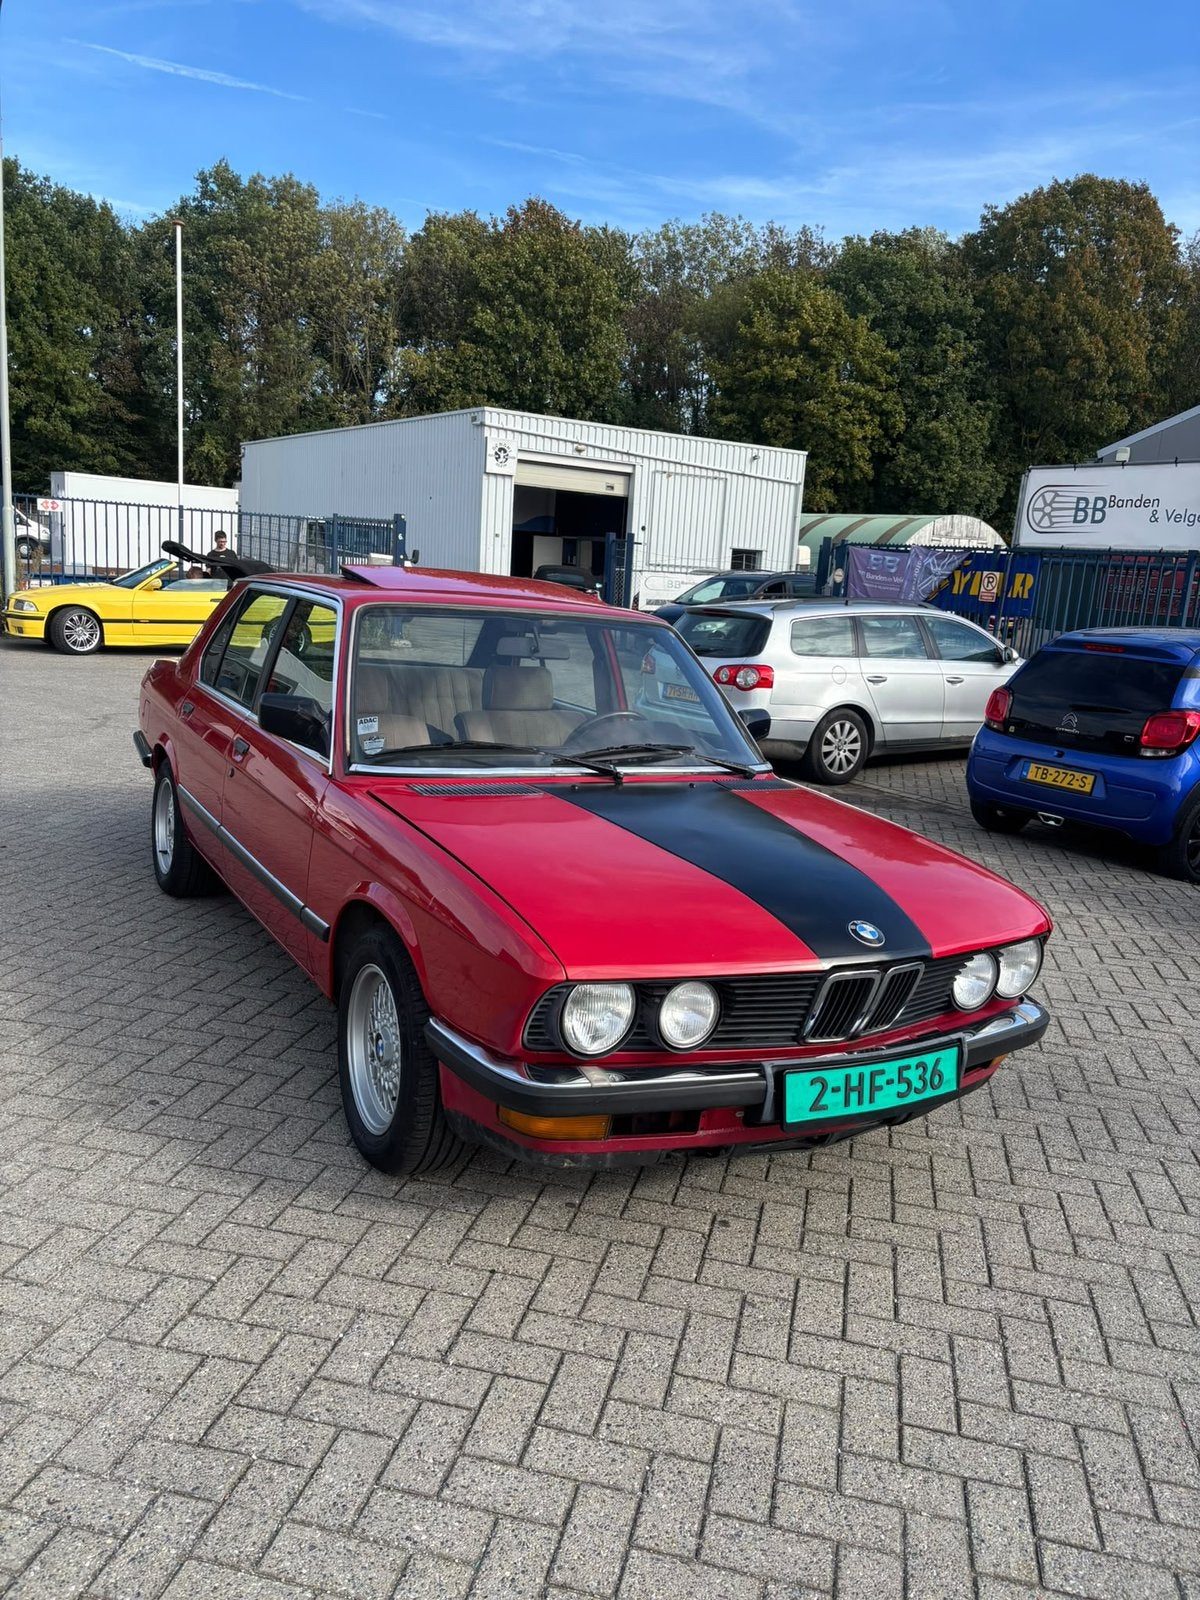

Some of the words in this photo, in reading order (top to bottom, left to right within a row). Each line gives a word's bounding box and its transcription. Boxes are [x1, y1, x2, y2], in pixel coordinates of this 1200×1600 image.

[1073, 496, 1110, 524] BB
[1108, 494, 1160, 509] Banden
[1149, 510, 1160, 523] &
[869, 553, 900, 573] BB
[866, 572, 887, 581] Banden
[1034, 766, 1088, 788] TB-272-S
[809, 1057, 944, 1112] 2-HF-536
